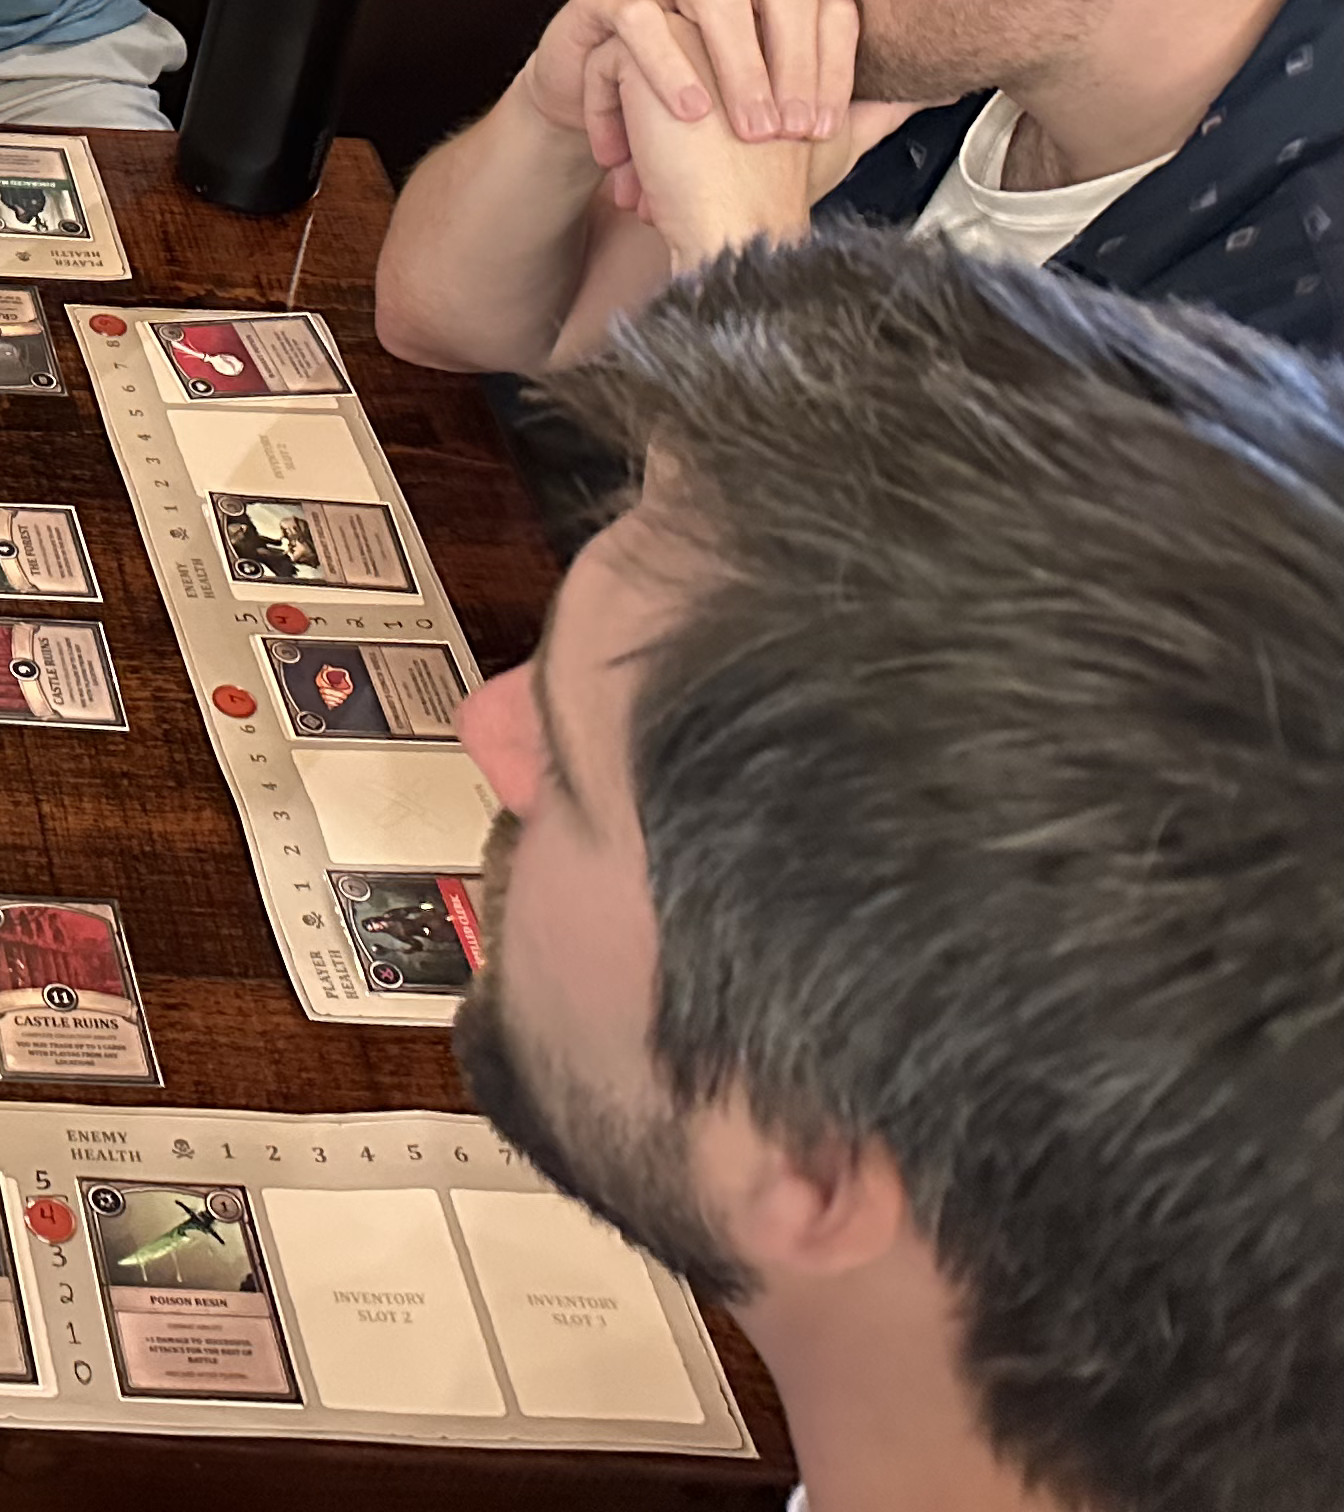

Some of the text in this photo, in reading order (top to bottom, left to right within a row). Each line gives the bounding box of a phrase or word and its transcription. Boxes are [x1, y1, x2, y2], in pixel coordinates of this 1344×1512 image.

[50, 250, 101, 258] HEALTH
[55, 259, 104, 267] PLAYER
[106, 340, 121, 348] 8
[123, 384, 136, 393] 6
[130, 409, 144, 417] 5
[137, 433, 152, 441] 4
[146, 456, 161, 465] 3
[155, 479, 170, 489] 2
[164, 505, 179, 513] 1
[18, 524, 40, 576] THE FOREST
[176, 561, 198, 599] ENEMY
[191, 557, 215, 599] HEALTH
[235, 612, 258, 623] 5
[276, 615, 289, 625] 4
[309, 616, 327, 626] 3
[346, 617, 364, 628] 2
[384, 620, 402, 629] 1
[38, 637, 64, 705] CASTLE RUINS
[240, 724, 256, 734] 6
[250, 753, 267, 763] 5
[261, 781, 278, 791] 4
[272, 809, 291, 821] 3
[283, 844, 301, 856] 2
[294, 880, 311, 892] 1
[309, 950, 339, 1000] PLAYER
[327, 949, 359, 1000] HEALTH
[51, 990, 71, 1006] 11
[14, 1015, 119, 1030] CASTLE RUINS
[67, 1130, 128, 1145] ENEMY
[71, 1148, 142, 1163] HEALTH
[222, 1143, 234, 1159] 1
[266, 1145, 281, 1161] 2
[312, 1147, 327, 1164] 3
[359, 1145, 375, 1162] 4
[408, 1143, 423, 1161] 5
[454, 1146, 468, 1163] 6
[35, 1171, 50, 1190] 5
[39, 1204, 55, 1224] 4
[52, 1245, 67, 1267] 3
[60, 1283, 74, 1305] 2
[150, 1295, 228, 1308] POISON RESIN
[332, 1290, 426, 1307] INVENTORY
[527, 1294, 619, 1311] INVENTORY
[358, 1308, 412, 1324] SLOT 2
[552, 1312, 590, 1327] SLOT
[69, 1322, 80, 1345] 1
